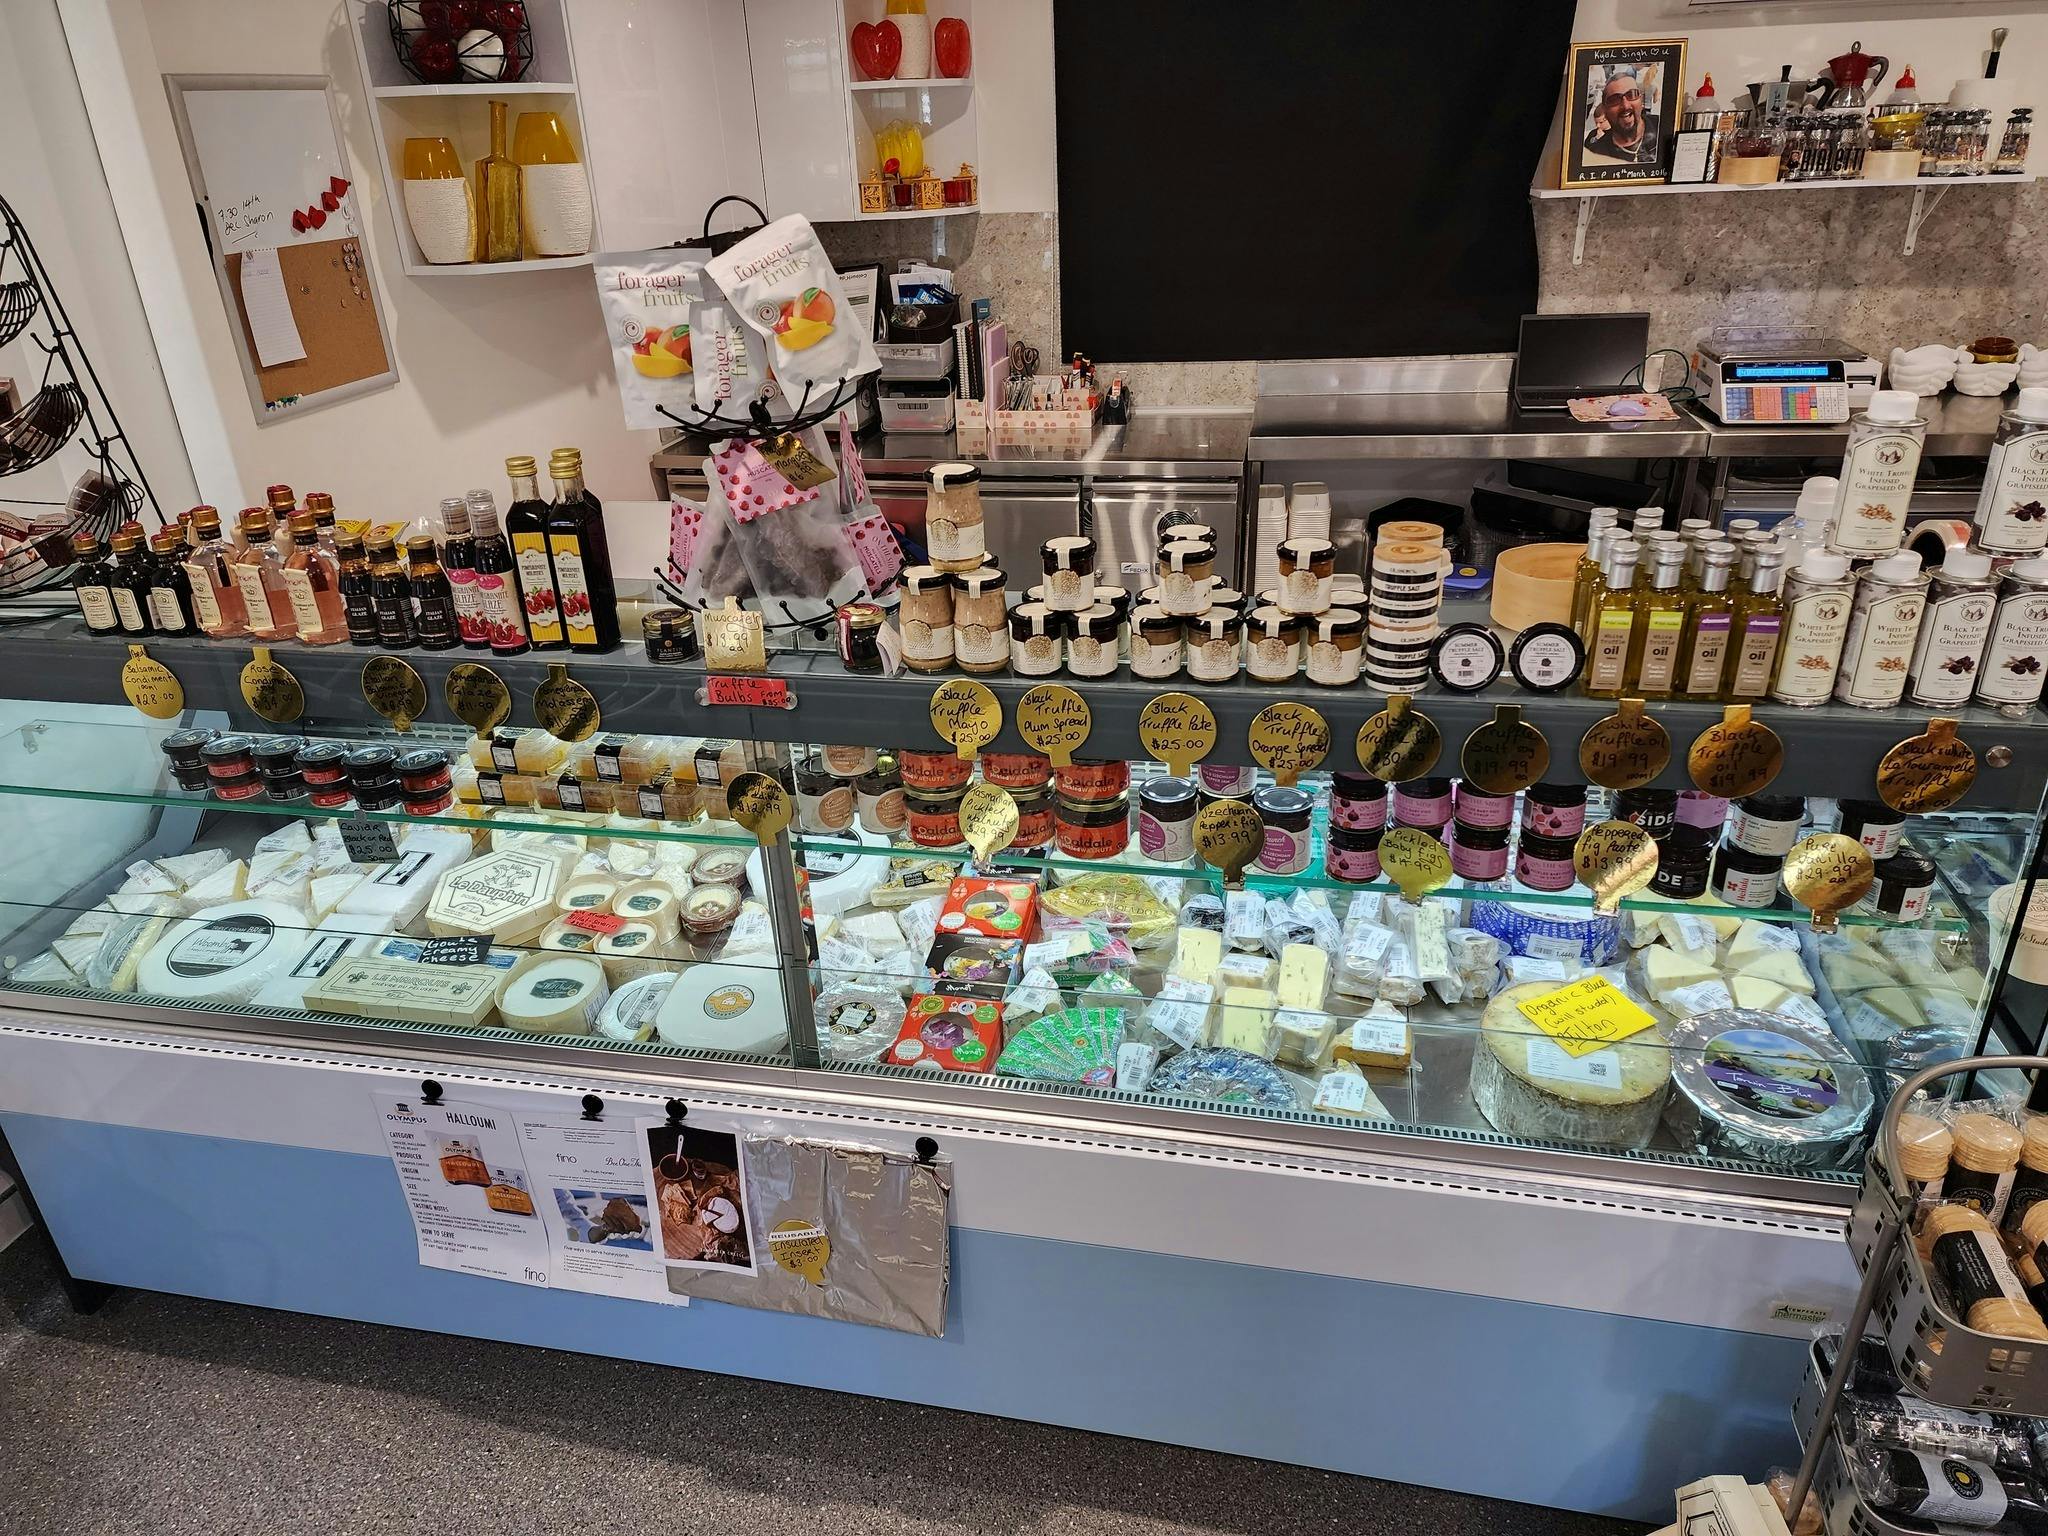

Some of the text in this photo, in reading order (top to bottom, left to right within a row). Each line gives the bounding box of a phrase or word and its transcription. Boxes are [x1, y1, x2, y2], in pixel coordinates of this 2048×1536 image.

[1621, 48, 1648, 61] Singh
[1578, 173, 1586, 181] R
[1626, 169, 1647, 179] March
[218, 207, 238, 222] 7.30
[243, 211, 274, 228] Sharon
[733, 241, 793, 283] forager
[762, 255, 810, 288] fruits
[617, 272, 686, 291] forager
[642, 288, 697, 308] fruits
[731, 324, 748, 378] fruits
[714, 331, 733, 401] forager
[1859, 467, 1884, 477] WHITE
[2011, 466, 2037, 476] BLACK
[1855, 482, 1896, 492] GRAPESEED
[1869, 476, 1900, 485] INFUSED
[863, 545, 883, 575] MUSCATELS
[704, 612, 761, 632] Muscatels
[1798, 622, 1824, 631] WHITE
[1943, 624, 1967, 633] BLACK
[1603, 646, 1619, 656] oil
[1652, 646, 1668, 657] oil
[1701, 648, 1717, 658] oil
[126, 664, 165, 674] Balsamic
[250, 664, 279, 674] Rose
[125, 674, 174, 684] Condiment
[243, 675, 294, 687] Condiment
[707, 678, 762, 690] Truffle
[135, 692, 175, 706] $28.00
[452, 685, 496, 698] Glaze
[716, 689, 753, 703] Bulbs
[940, 687, 978, 701] Black
[1024, 690, 1054, 706] Black
[457, 700, 495, 713] $11.99
[931, 702, 985, 719] Truffle
[1035, 698, 1085, 715] Truffle
[1151, 701, 1188, 715] Black
[1140, 714, 1214, 732] Truffle Pate
[1260, 708, 1302, 723] Black
[948, 717, 989, 735] Mayo
[1024, 715, 1088, 733] Plum Spread
[1264, 722, 1321, 737] Truffle
[951, 731, 991, 744] $25.00
[1036, 731, 1080, 747] $25.00
[1360, 729, 1411, 746] Truffle
[1588, 731, 1643, 747] Truffle
[1710, 729, 1760, 743] Black
[1151, 738, 1204, 751] $25.00
[1252, 739, 1328, 760] Orange Spread
[1696, 742, 1764, 761] Truffle
[1268, 757, 1314, 769] $25.00
[1591, 752, 1649, 770] $19.99
[1903, 755, 1976, 776] Tourangelle
[970, 786, 1015, 810] Tasmanian
[965, 799, 1005, 816] Pickled
[1201, 805, 1255, 820] Szechuan
[1199, 816, 1257, 833] Pepper fig
[1637, 813, 1674, 827] SIDE
[966, 825, 1006, 843] $29.99
[1202, 830, 1252, 850] $13.99
[1394, 829, 1437, 852] Pickled
[1592, 824, 1645, 843] Peppered
[1384, 838, 1412, 859] Baby
[1581, 838, 1640, 855] fig Paste
[448, 875, 530, 906] Le Dauphin
[421, 944, 479, 957] creamy
[421, 953, 480, 965] cheese
[1524, 978, 1609, 1017] Organic Blue
[1544, 993, 1617, 1029] (will studd)
[1774, 1083, 1814, 1101] Blue
[386, 1111, 498, 1131] OLYMPUS HALLOUMI
[389, 1131, 415, 1140] CATEGORY
[395, 1151, 423, 1161] PRODUCER
[556, 1153, 578, 1165] fino
[401, 1166, 419, 1175] ORIGIN
[413, 1202, 450, 1213] TASTING NOTES
[421, 1228, 456, 1239] HOW TO SERVE
[770, 1230, 822, 1240] REUSABLE
[771, 1237, 824, 1252] Insulated
[780, 1246, 821, 1262] Insert
[524, 1266, 547, 1284] fino
[1774, 1309, 1826, 1323] thermaster
